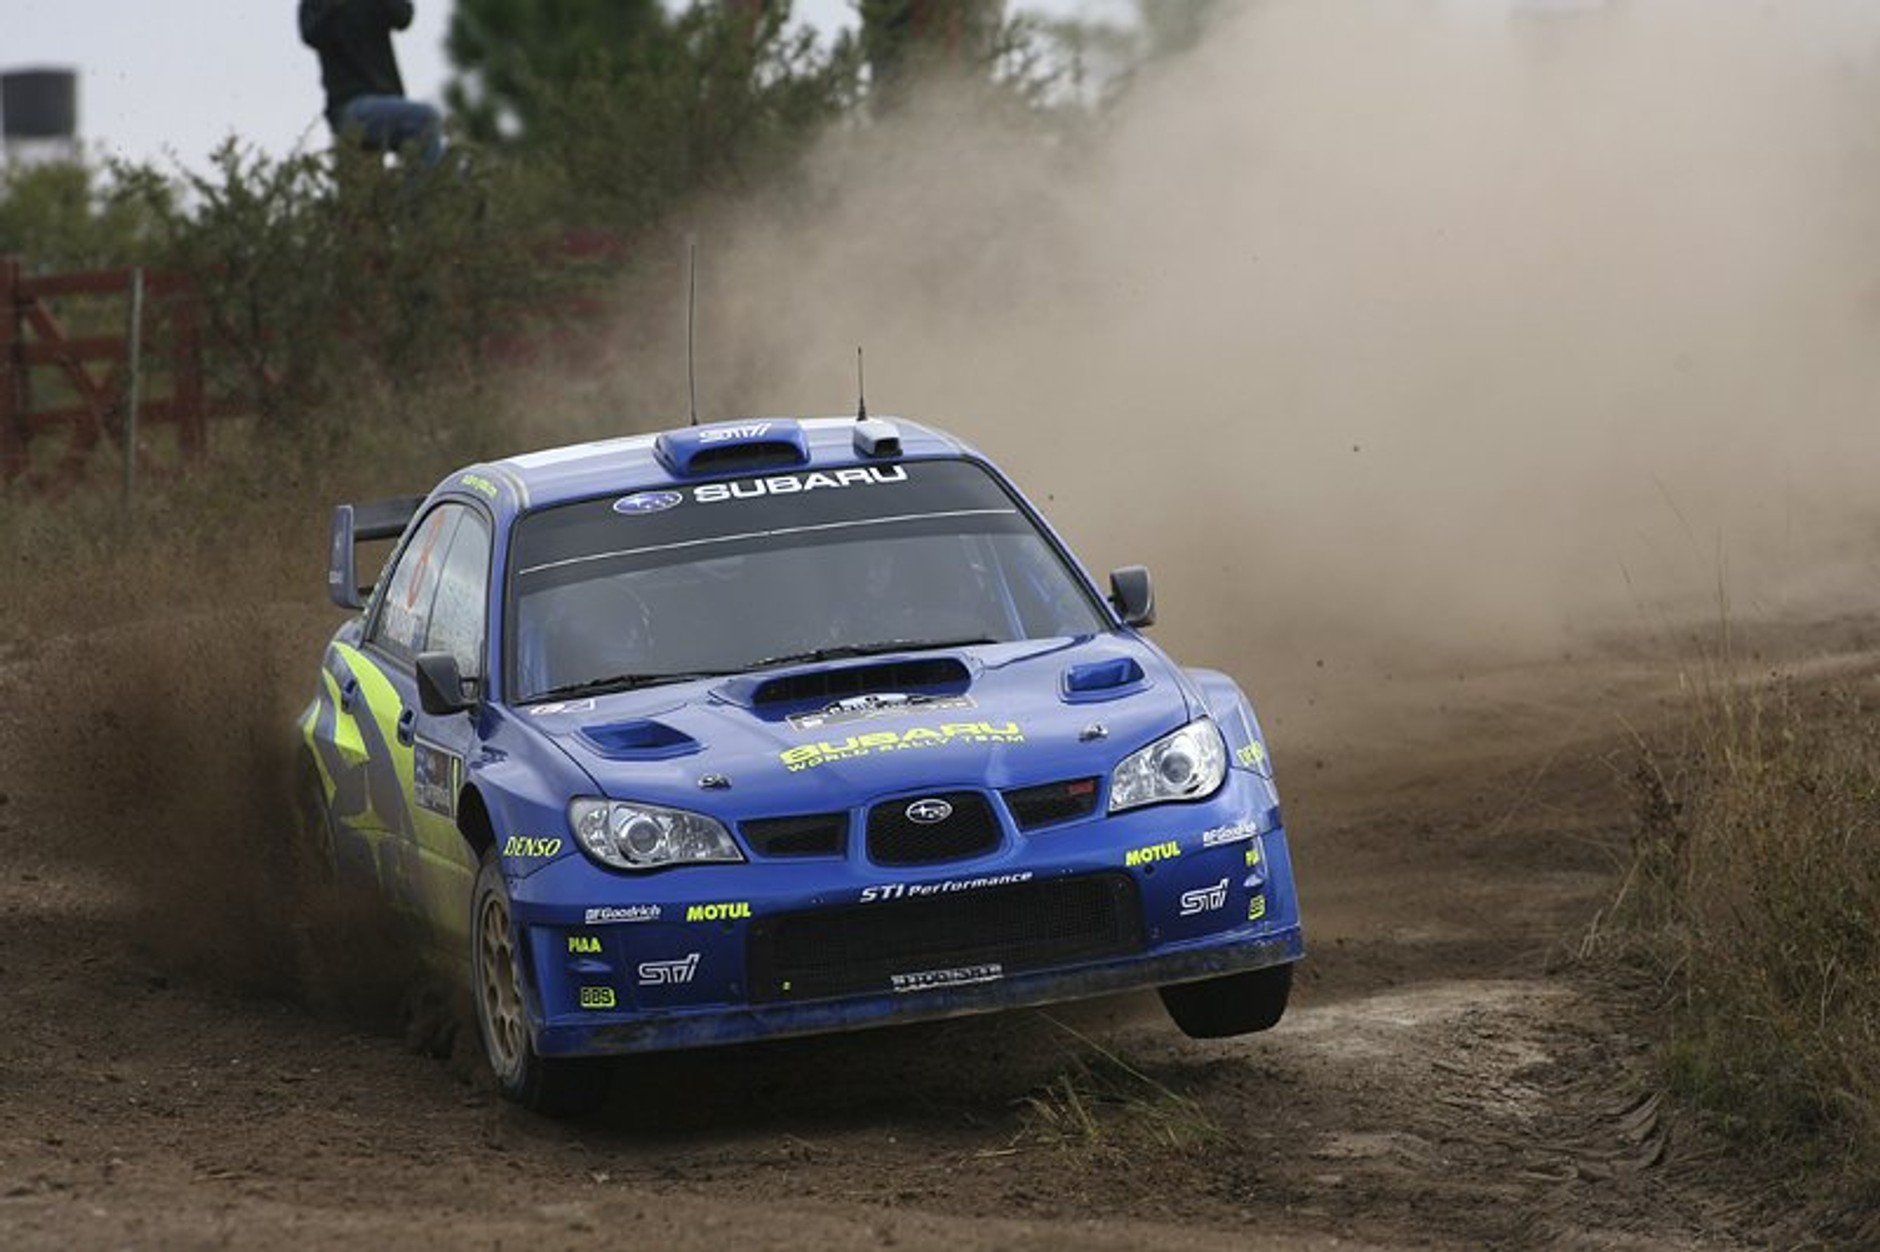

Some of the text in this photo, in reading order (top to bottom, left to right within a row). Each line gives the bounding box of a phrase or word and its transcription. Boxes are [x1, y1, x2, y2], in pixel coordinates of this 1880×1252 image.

[692, 465, 908, 502] SUBARU
[779, 722, 1021, 765] SUBARU
[787, 733, 1025, 772] WORLD RALLY TEAM
[503, 836, 562, 857] DENSO
[1125, 841, 1181, 866] MOTUL
[859, 871, 1034, 903] STI Performance
[585, 904, 662, 923] BFGoodrich
[687, 901, 752, 922] MOTUL
[568, 937, 603, 953] PIAA
